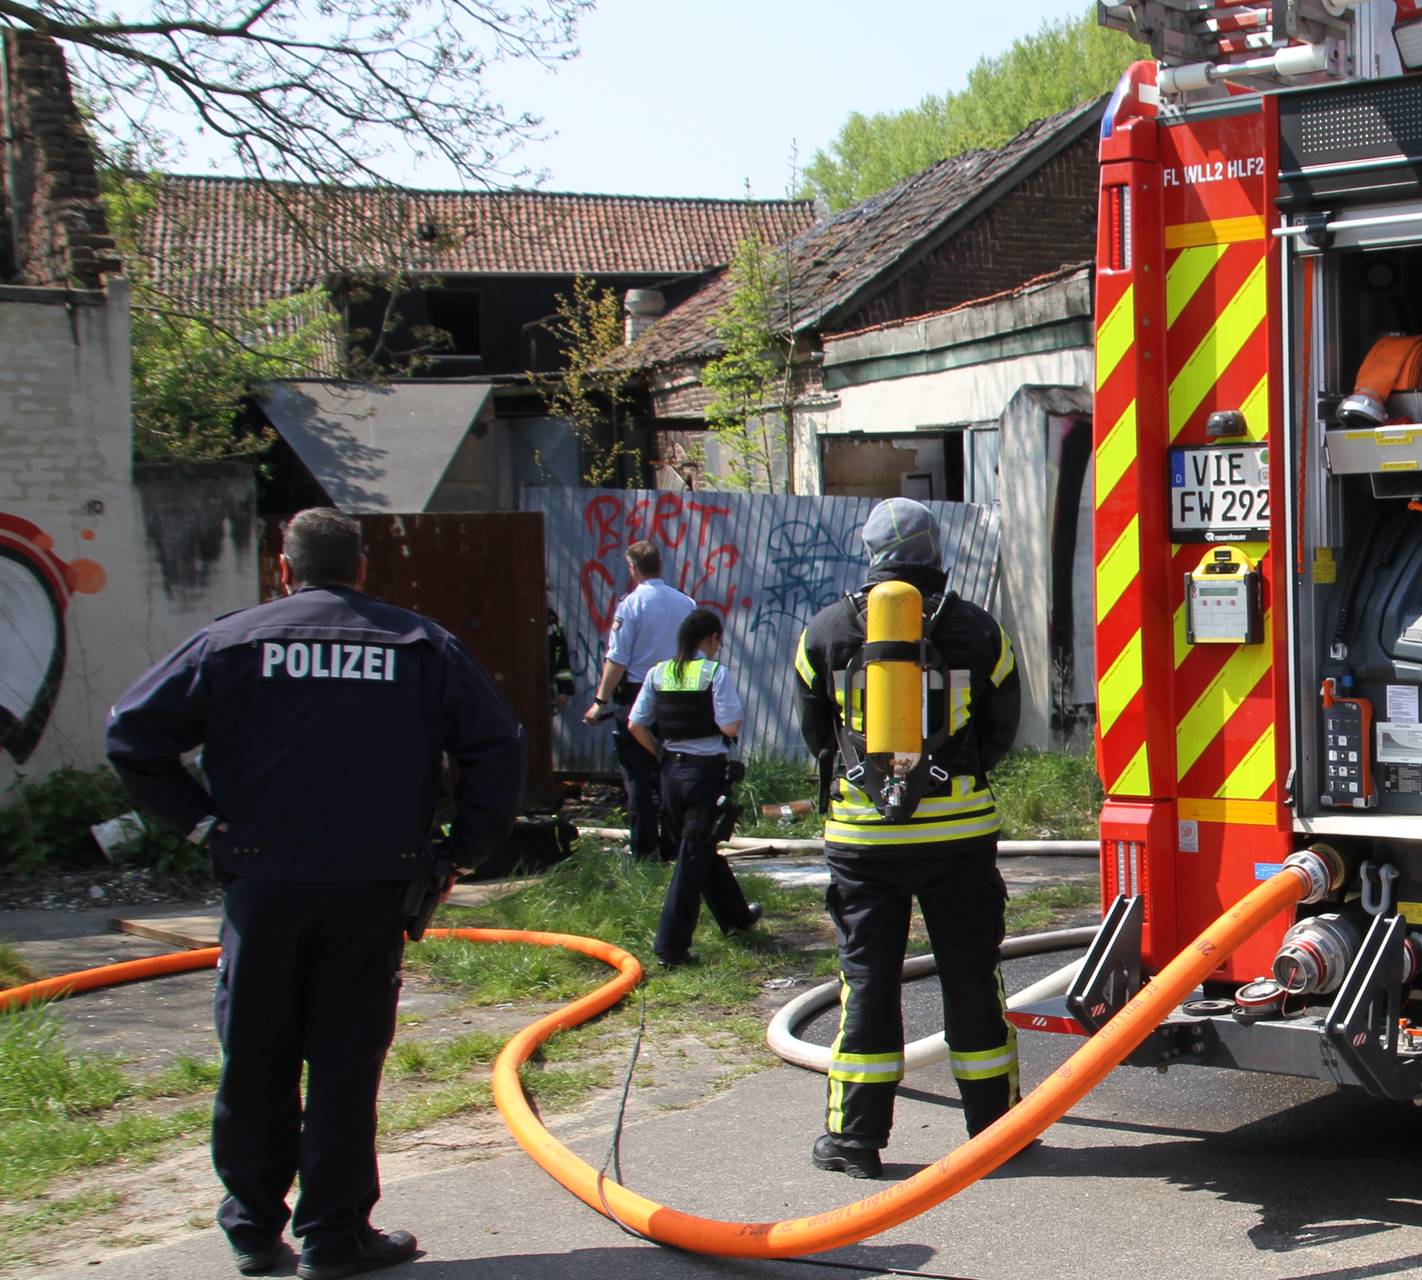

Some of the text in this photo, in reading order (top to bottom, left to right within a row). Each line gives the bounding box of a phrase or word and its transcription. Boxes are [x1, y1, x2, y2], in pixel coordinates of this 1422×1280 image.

[1163, 167, 1180, 187] FL
[1183, 161, 1224, 184] WLL2
[1175, 473, 1183, 484] D
[1192, 452, 1246, 487] VIE
[1180, 488, 1270, 522] FW 292
[262, 641, 395, 681] POLIZEI
